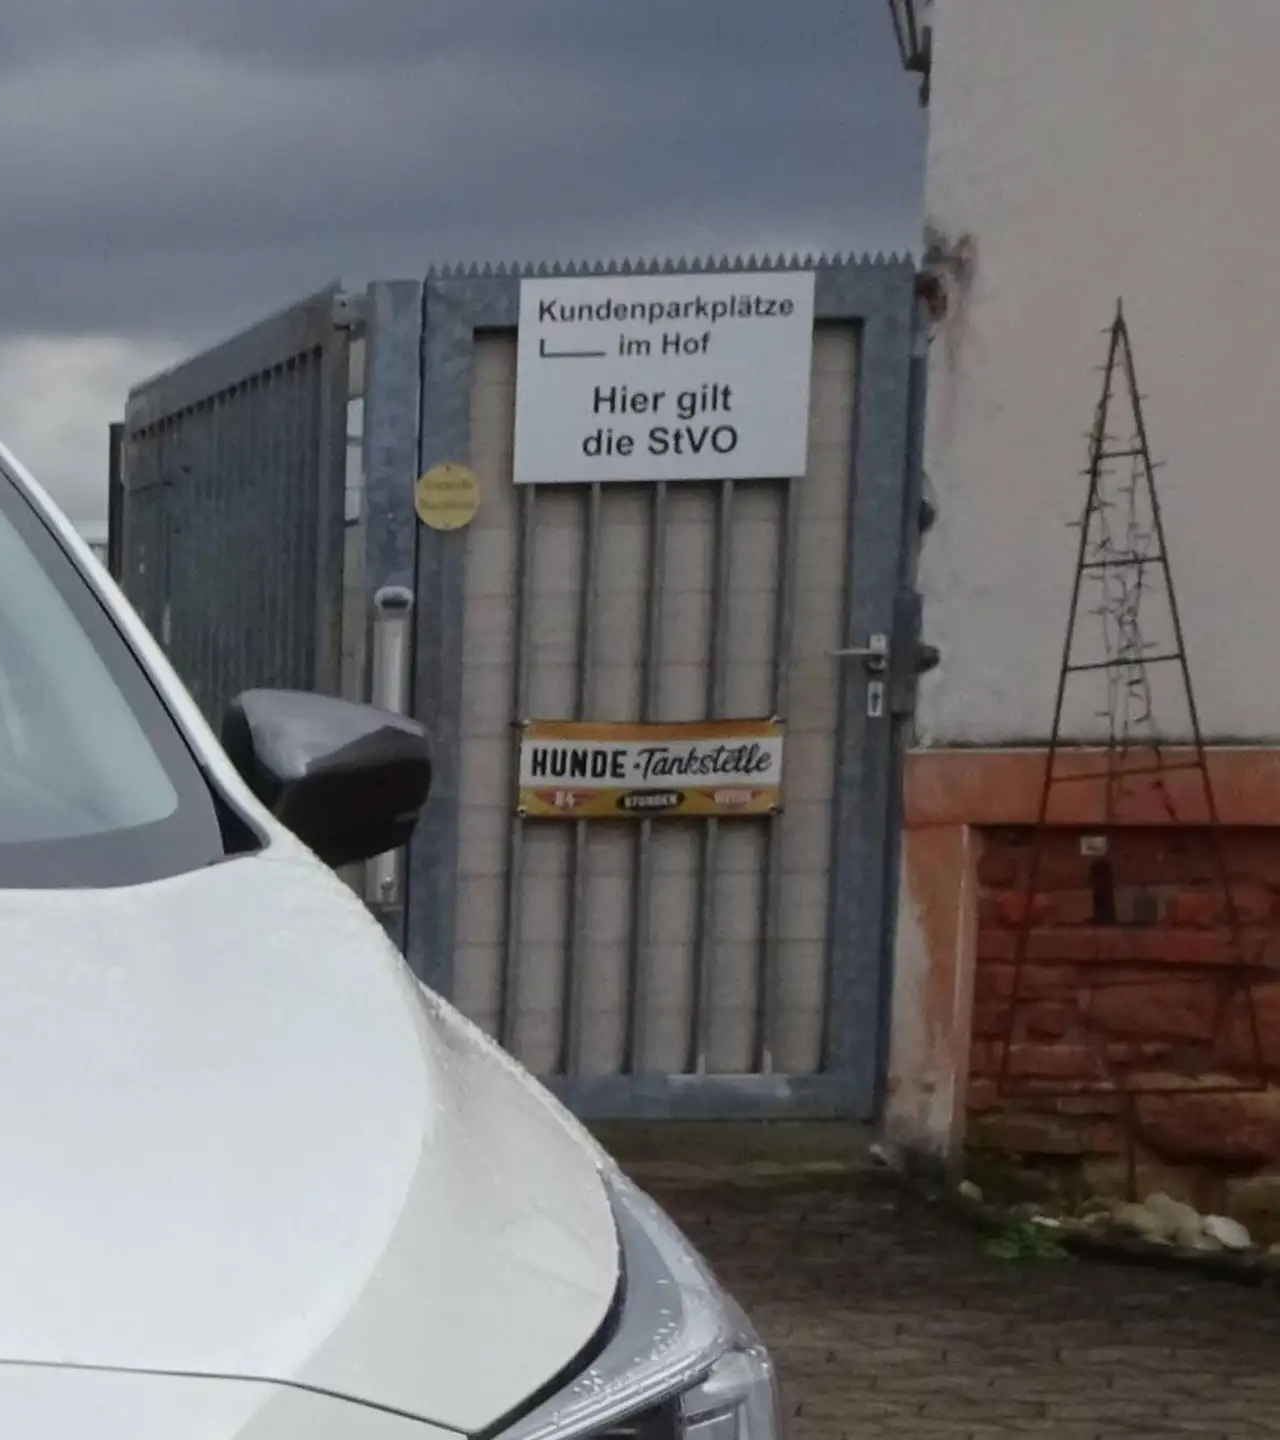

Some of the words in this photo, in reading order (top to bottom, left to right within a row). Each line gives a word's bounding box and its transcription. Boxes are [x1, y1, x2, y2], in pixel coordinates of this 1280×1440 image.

[538, 296, 796, 324] Kundenparkplätze
[618, 334, 652, 357] im
[661, 331, 712, 356] Hof
[592, 385, 667, 415] Hier
[676, 383, 734, 420] gilt
[581, 428, 635, 457] die
[647, 425, 739, 455] StVO
